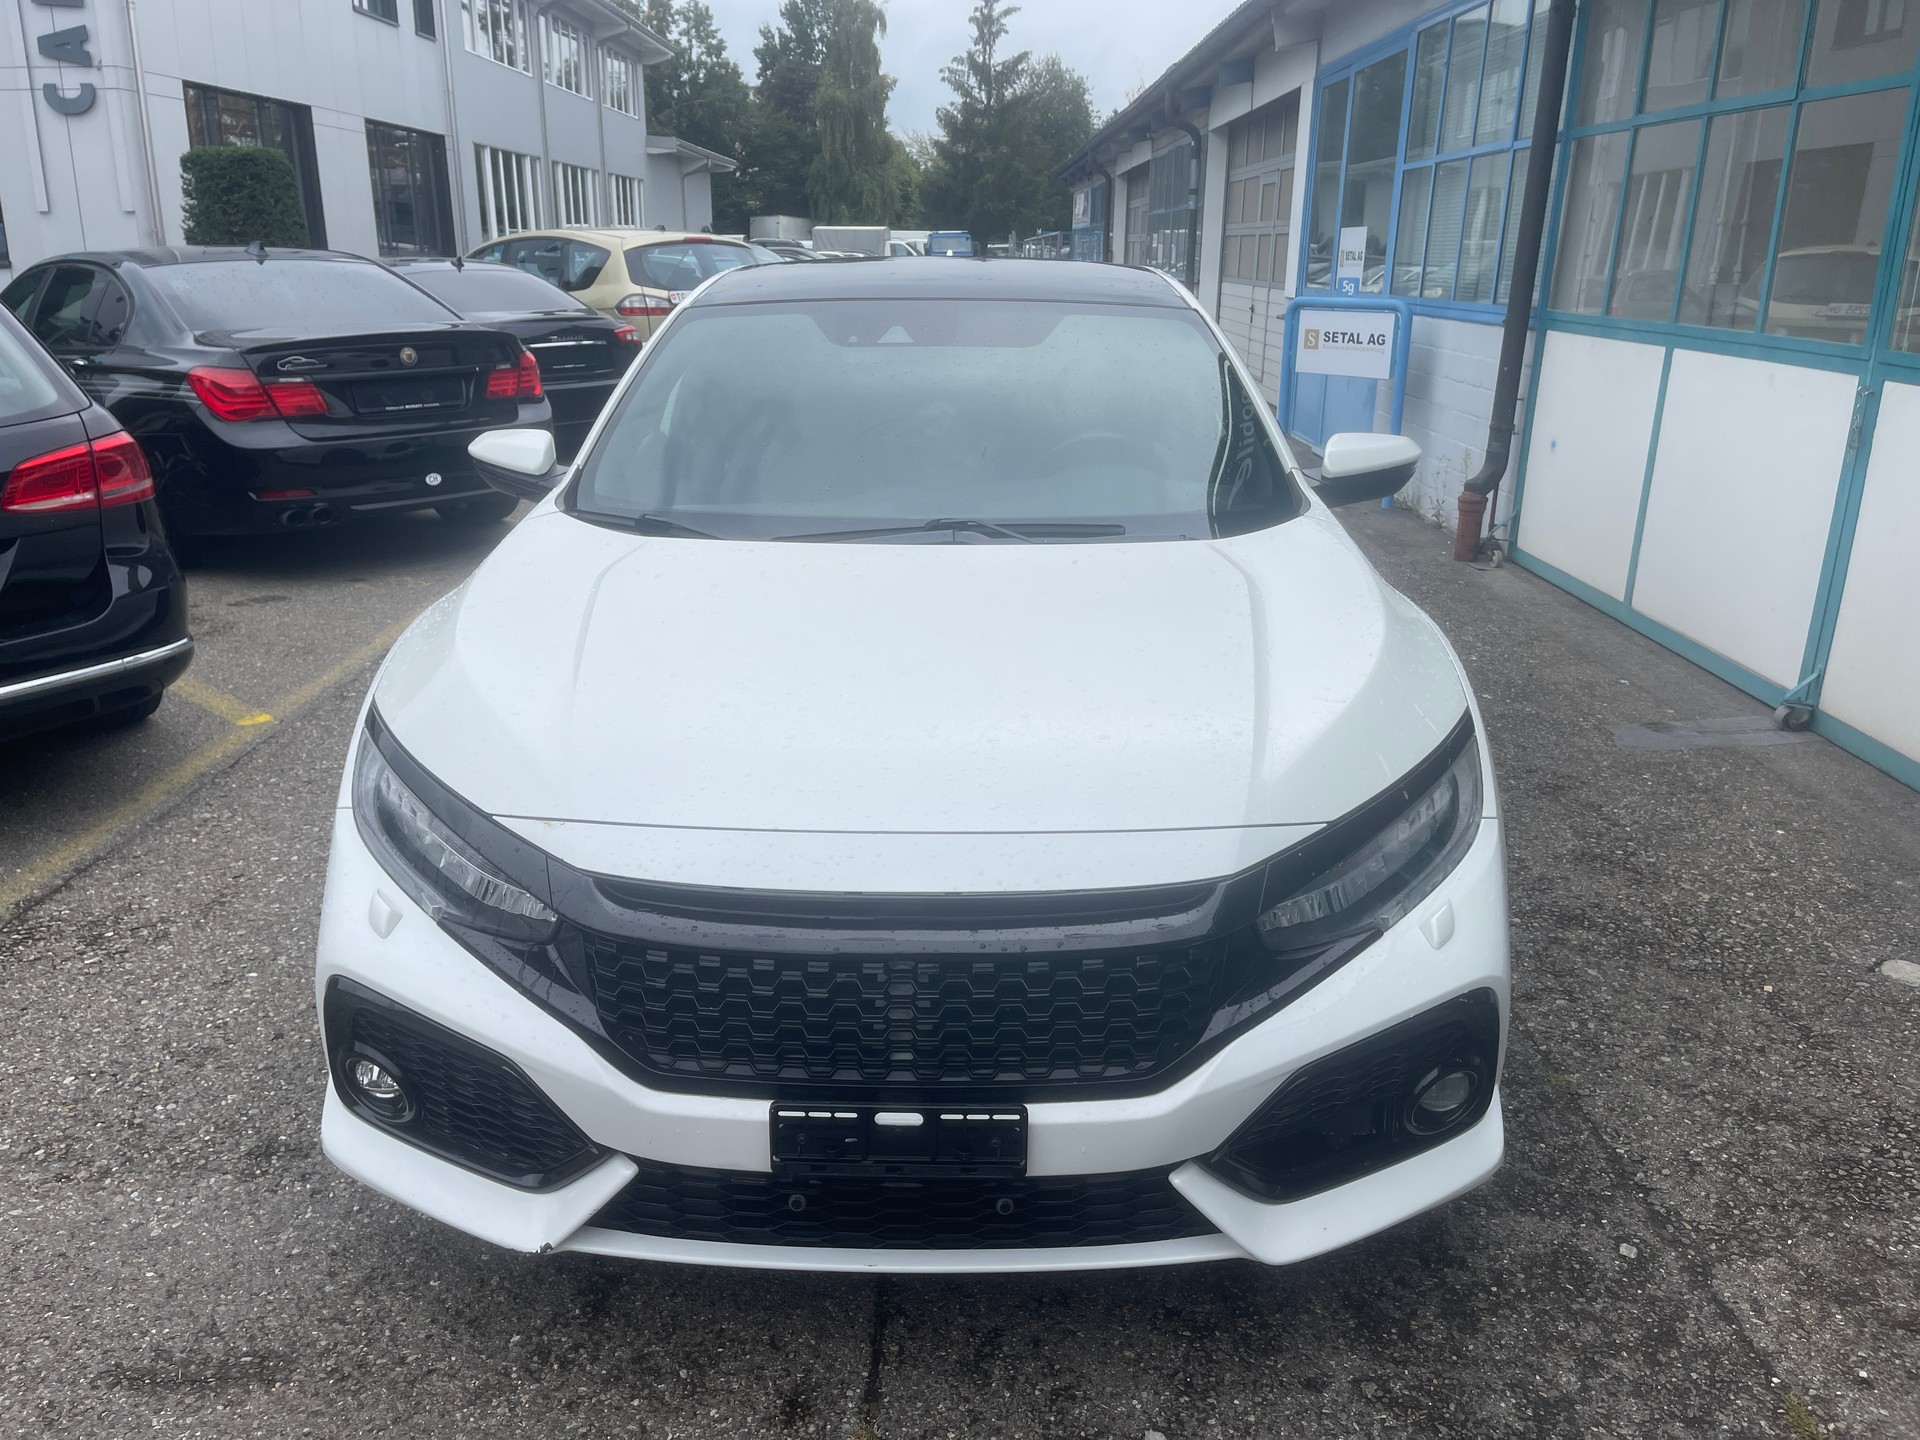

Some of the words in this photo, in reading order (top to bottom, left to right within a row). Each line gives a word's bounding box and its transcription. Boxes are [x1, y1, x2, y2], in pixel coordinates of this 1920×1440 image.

[31, 0, 96, 115] CA
[1342, 280, 1354, 295] 5g
[1323, 331, 1363, 344] SETAL
[1367, 333, 1386, 346] AG
